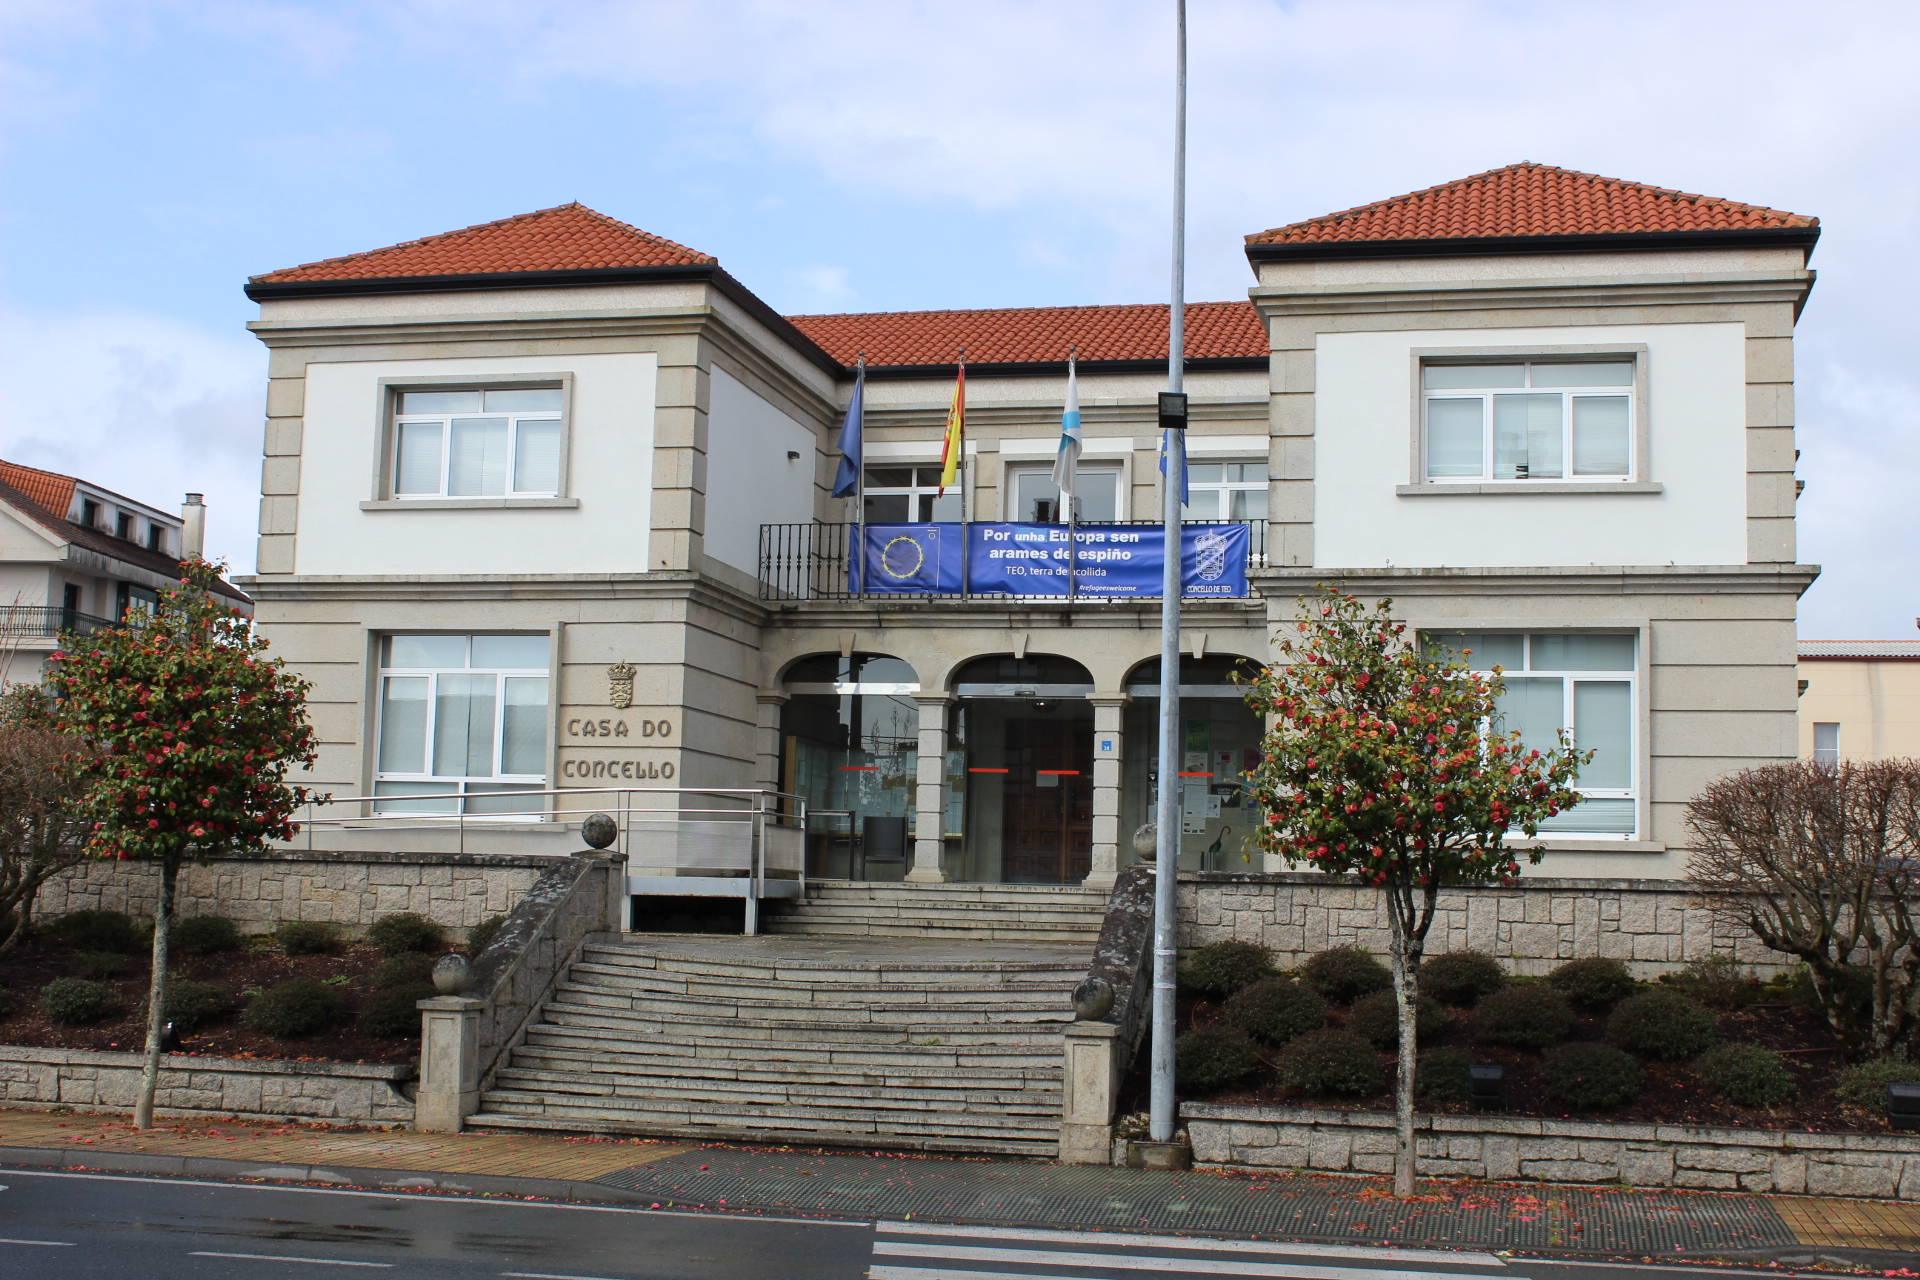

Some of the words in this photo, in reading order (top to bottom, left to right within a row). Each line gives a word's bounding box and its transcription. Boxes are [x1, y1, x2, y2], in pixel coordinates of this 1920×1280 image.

[983, 529, 1011, 541] Por
[1014, 531, 1045, 542] unha
[1110, 532, 1139, 543] sen
[989, 548, 1048, 560] arames
[1053, 548, 1070, 560] de
[1078, 548, 1132, 562] espiño
[1005, 565, 1027, 577] TEO,
[1030, 567, 1053, 576] terra
[1055, 566, 1068, 576] de
[1187, 585, 1213, 593] CONCELLO
[567, 719, 629, 737] CASA
[642, 719, 672, 737] DO
[562, 759, 675, 779] CONCELLO
